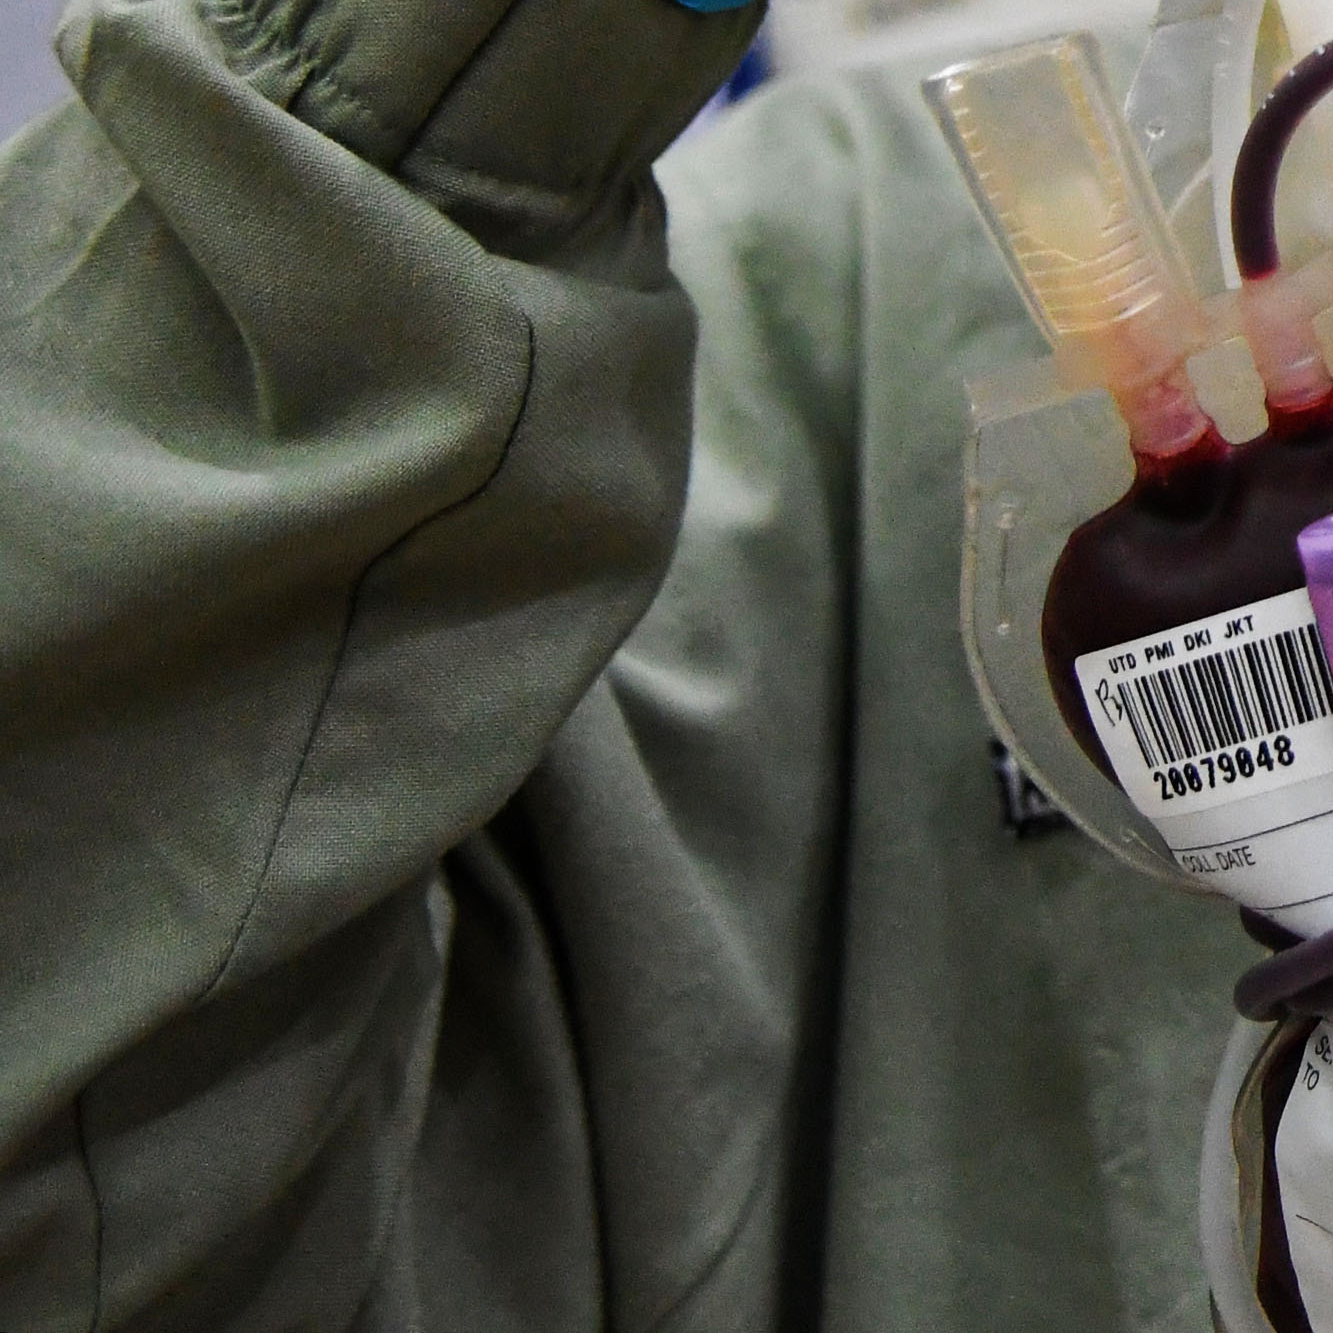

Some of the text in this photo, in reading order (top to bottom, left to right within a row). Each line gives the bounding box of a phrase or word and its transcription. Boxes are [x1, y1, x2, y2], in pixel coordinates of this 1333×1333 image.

[1109, 615, 1254, 674] UTD PMI DKI JKT
[1154, 734, 1295, 800] 20079048
[1217, 845, 1256, 871] DATE
